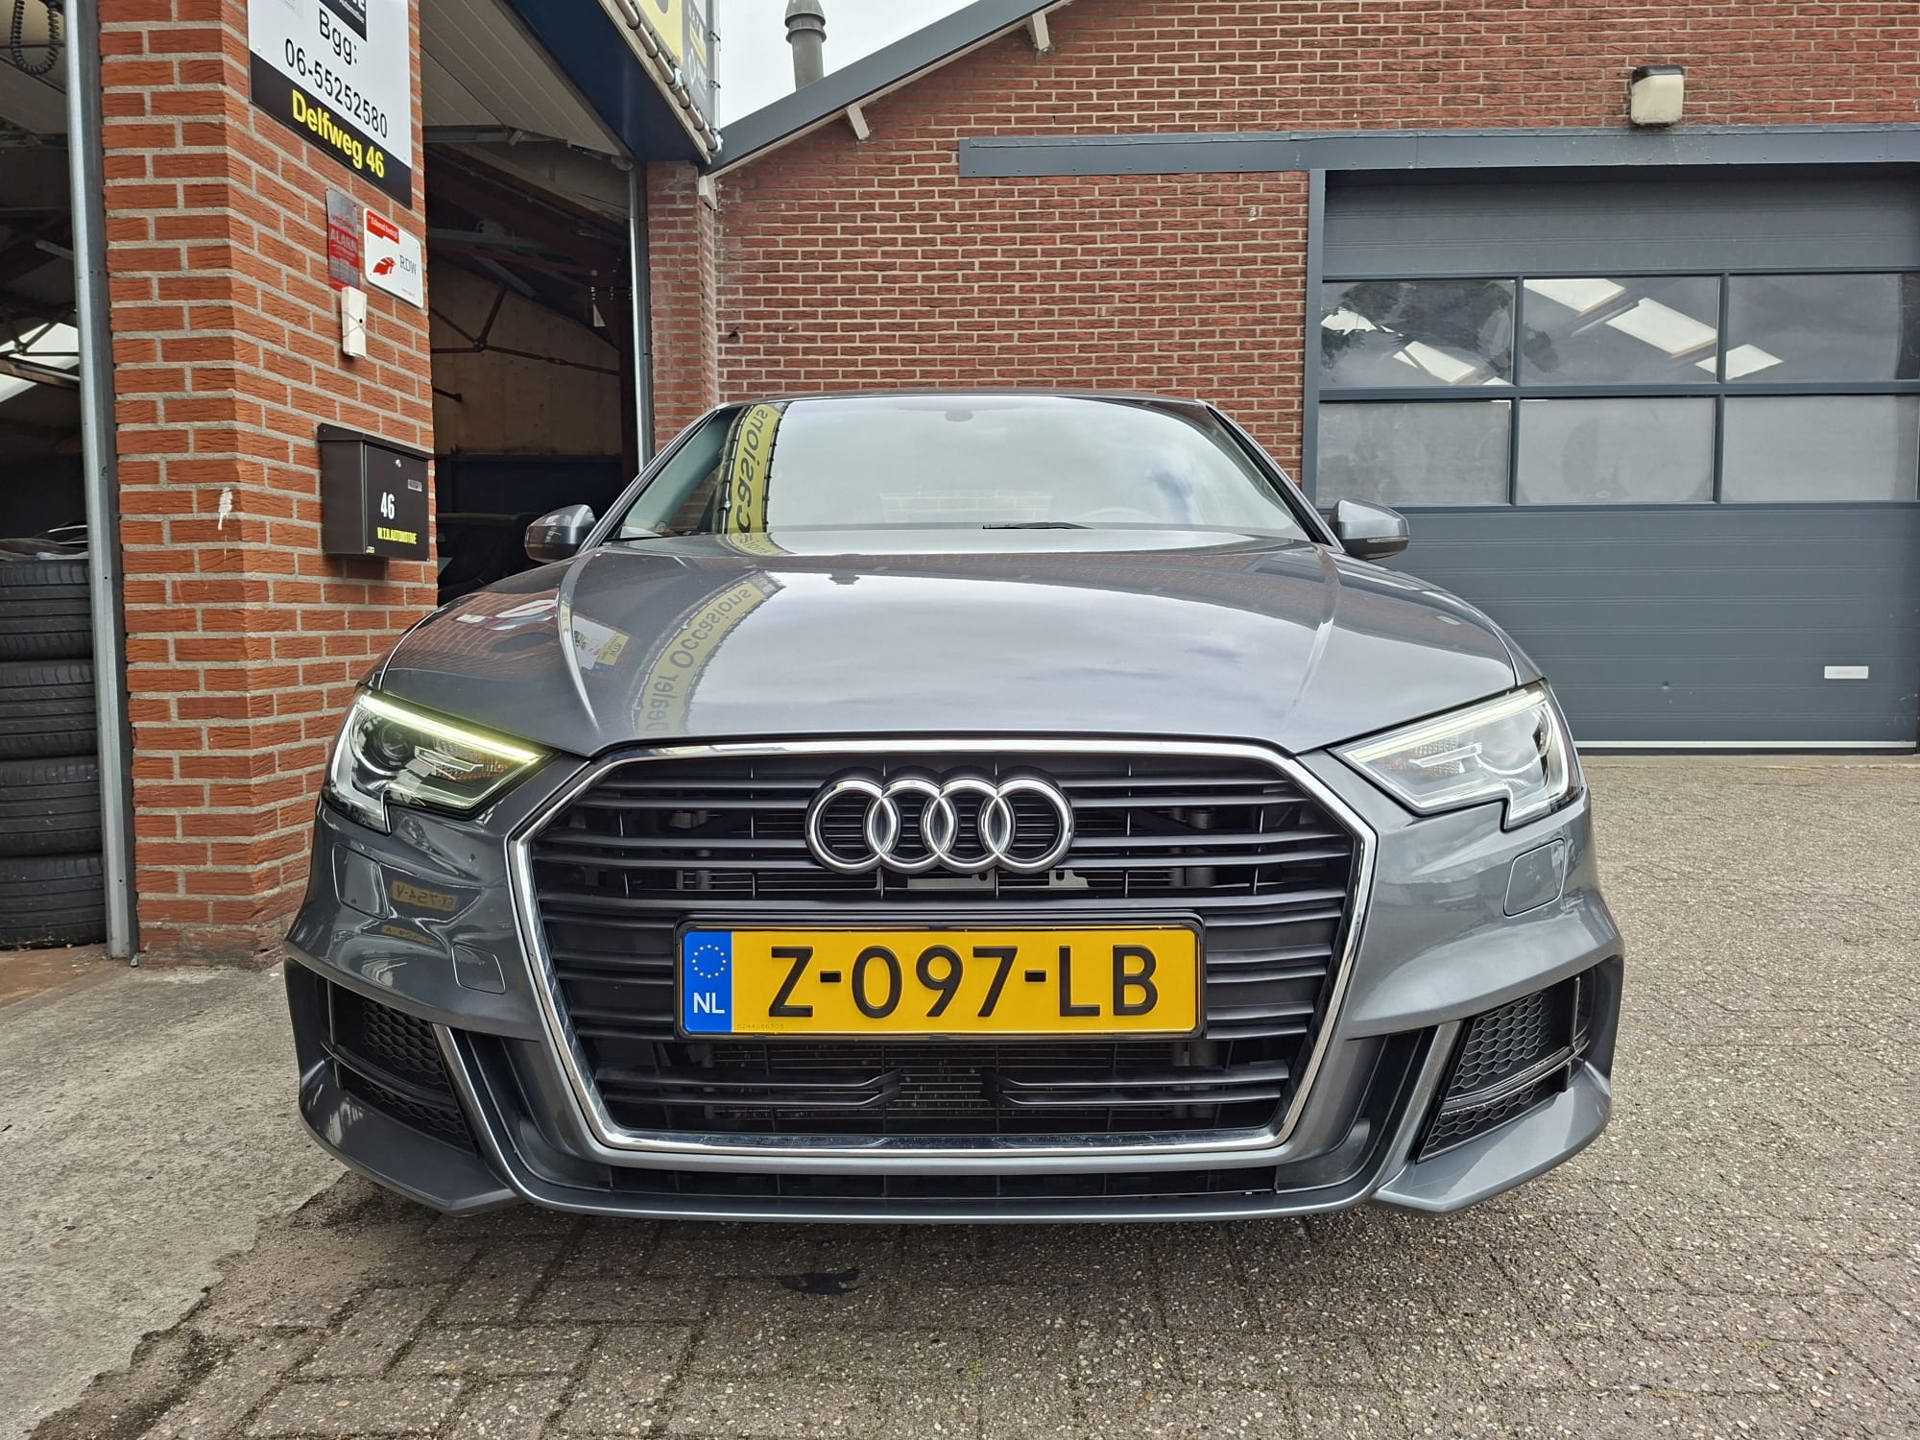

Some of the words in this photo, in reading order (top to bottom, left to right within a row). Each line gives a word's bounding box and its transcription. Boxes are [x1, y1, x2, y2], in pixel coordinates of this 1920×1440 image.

[319, 7, 358, 66] Bgg:
[284, 38, 388, 139] 06-55252580
[292, 89, 363, 170] Delfweg
[366, 145, 385, 178] 46
[399, 254, 417, 276] RDW
[380, 491, 396, 519] 46
[693, 992, 725, 1015] NL
[767, 944, 1159, 1019] Z-097-LB
